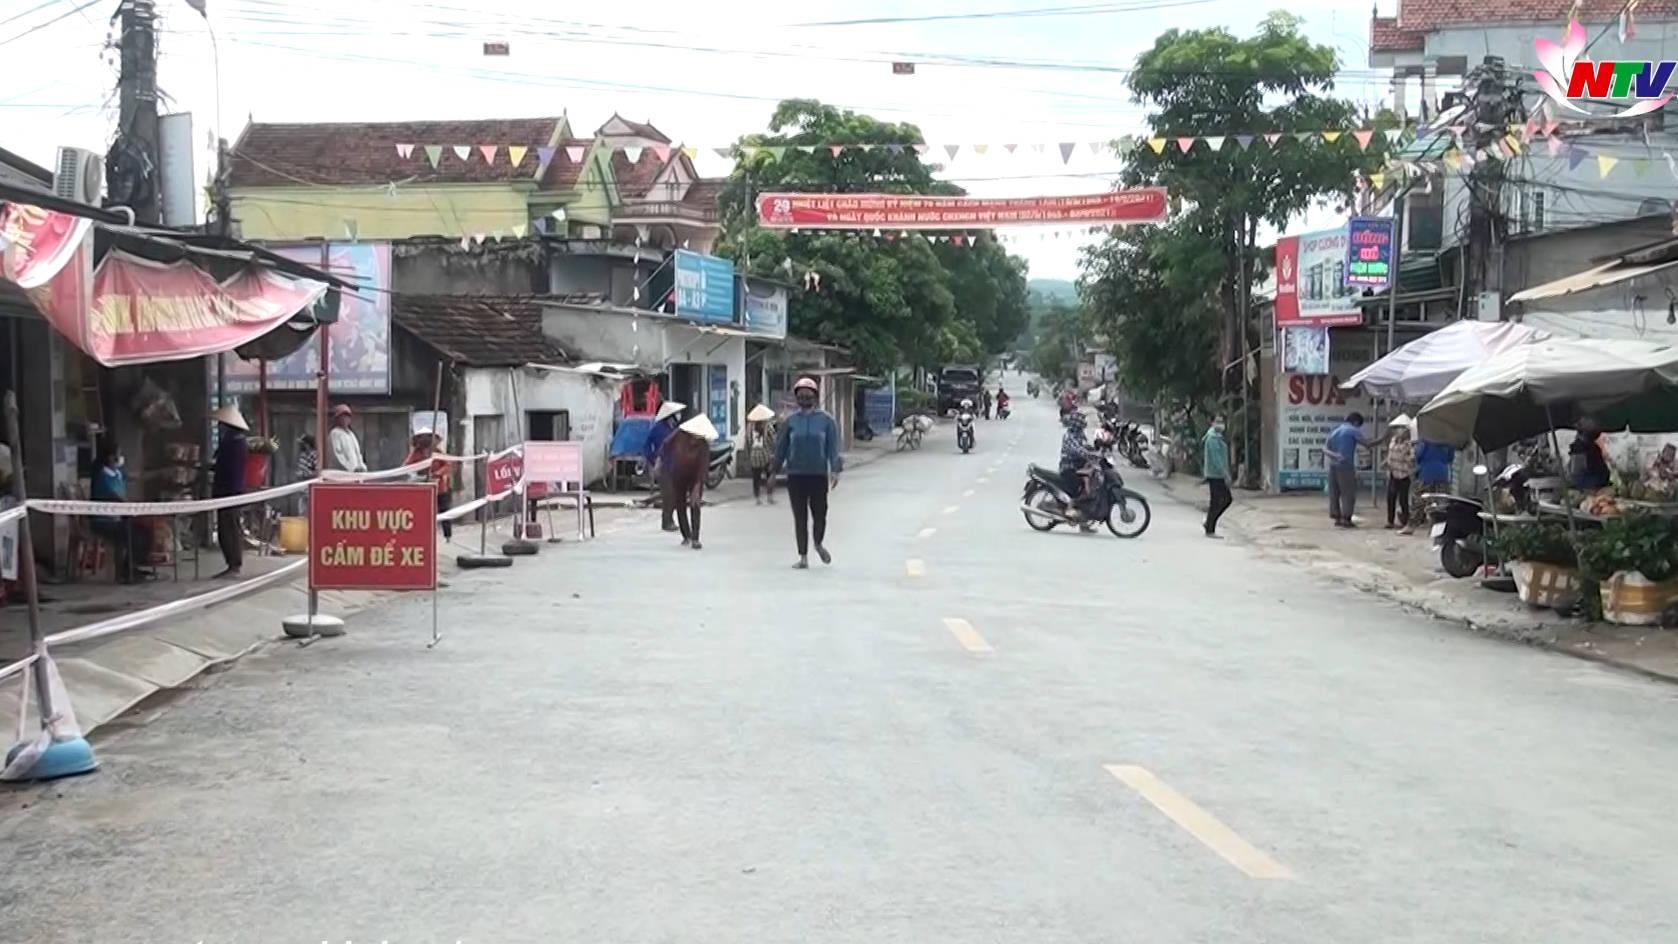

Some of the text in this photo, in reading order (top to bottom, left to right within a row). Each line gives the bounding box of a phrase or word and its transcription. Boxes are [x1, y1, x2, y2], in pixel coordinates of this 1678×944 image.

[494, 464, 512, 480] LỐI
[331, 508, 414, 534] KHU VỰC
[320, 538, 425, 566] CẤM ĐỂ XE
